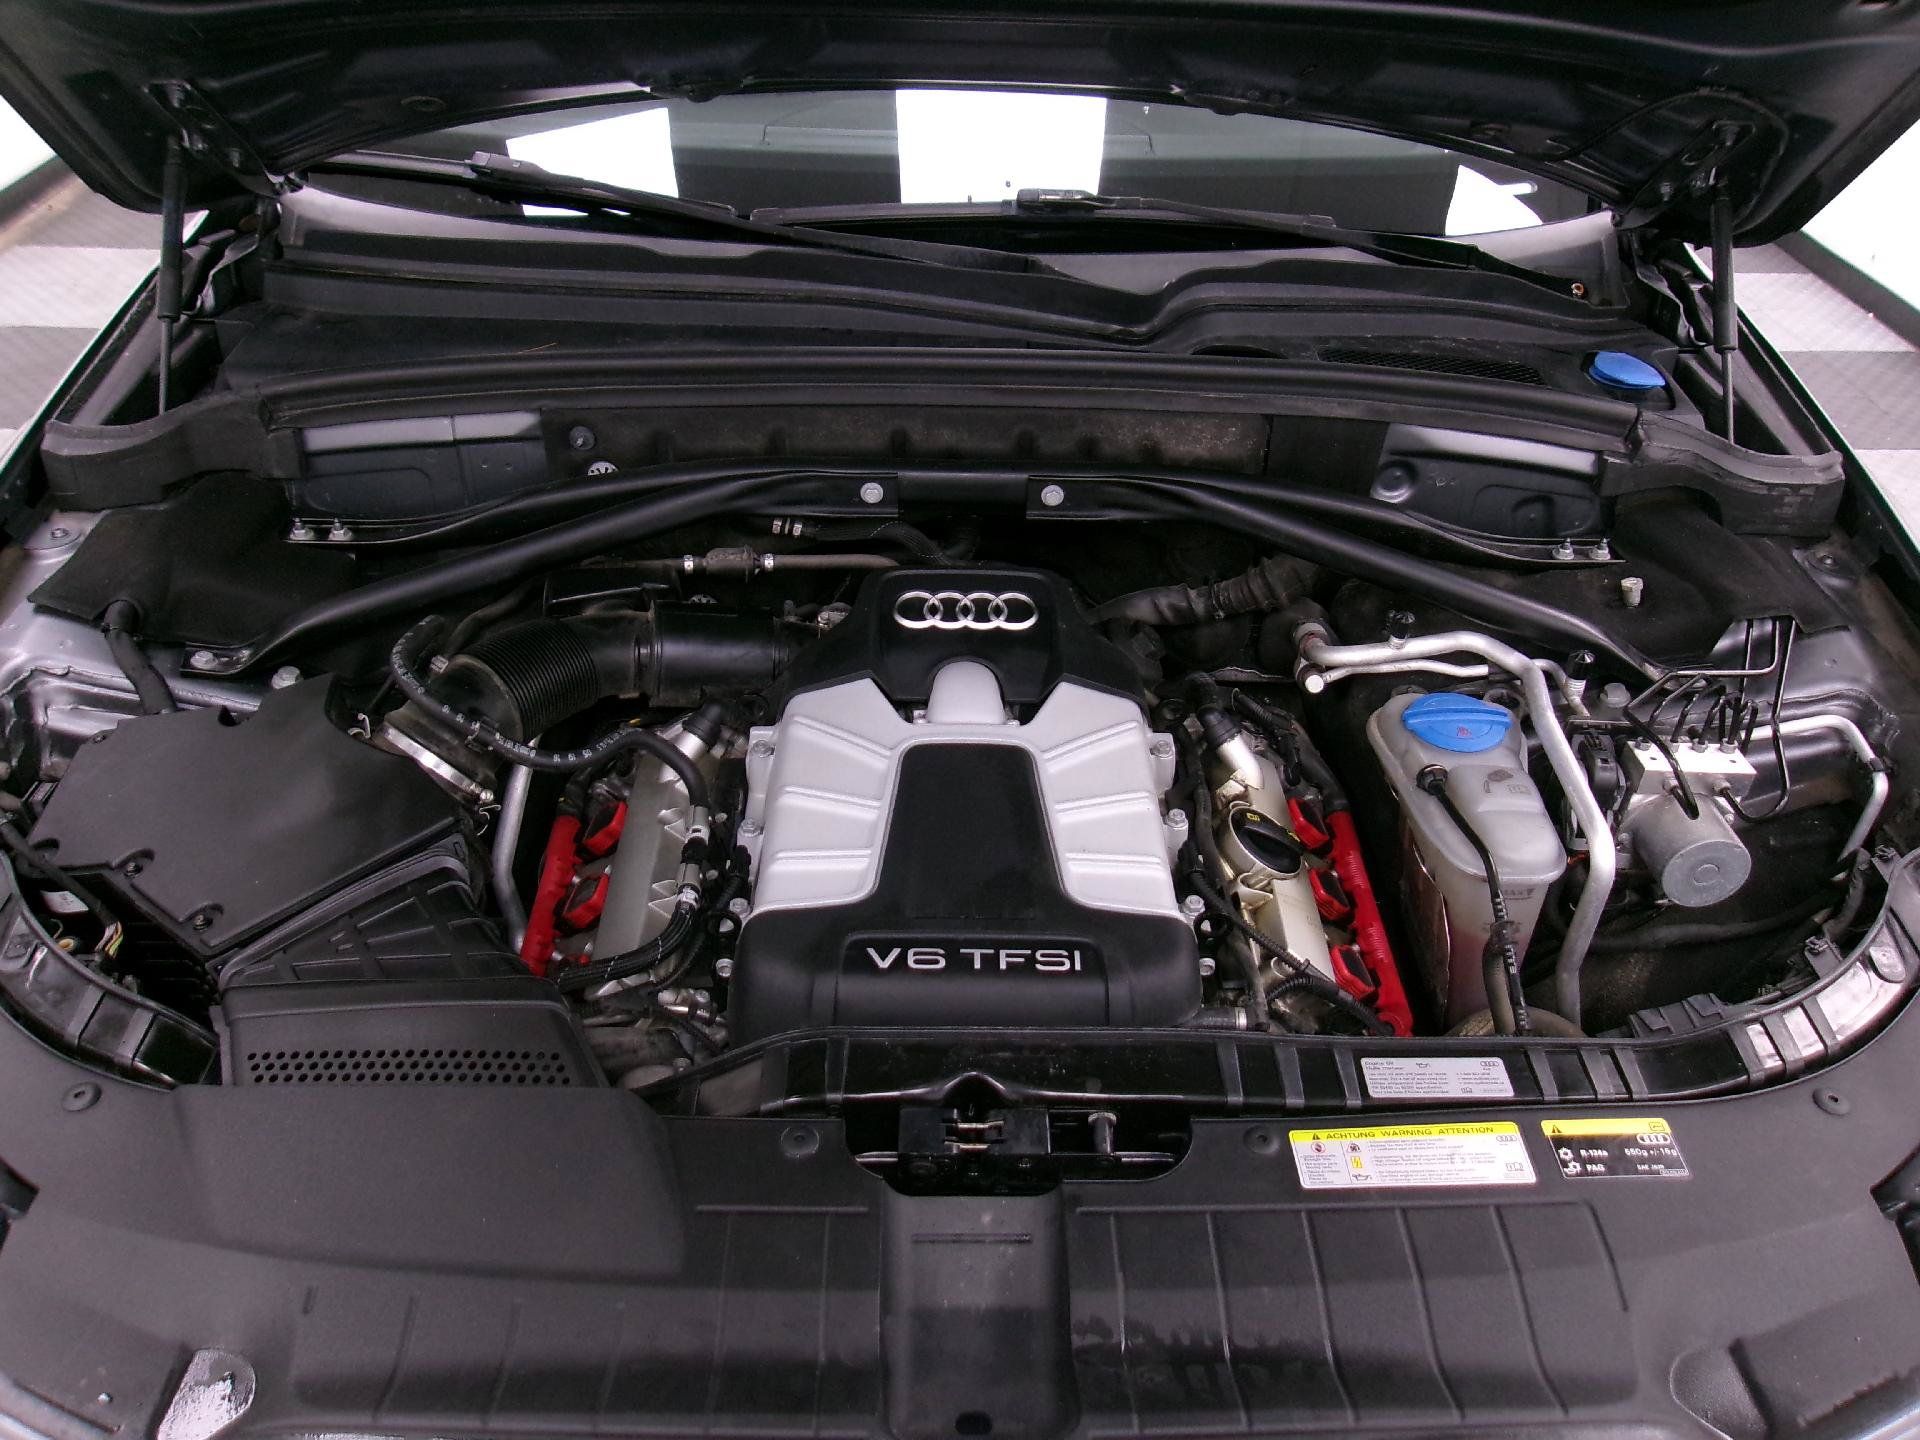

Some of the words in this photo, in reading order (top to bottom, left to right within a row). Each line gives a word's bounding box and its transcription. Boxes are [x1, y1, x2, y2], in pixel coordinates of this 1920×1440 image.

[866, 947, 946, 969] V6
[959, 948, 1081, 971] TFSI
[1326, 1130, 1376, 1140] ACHTUNG
[1380, 1128, 1433, 1137] WARNING
[1438, 1126, 1494, 1135] ATTENTION
